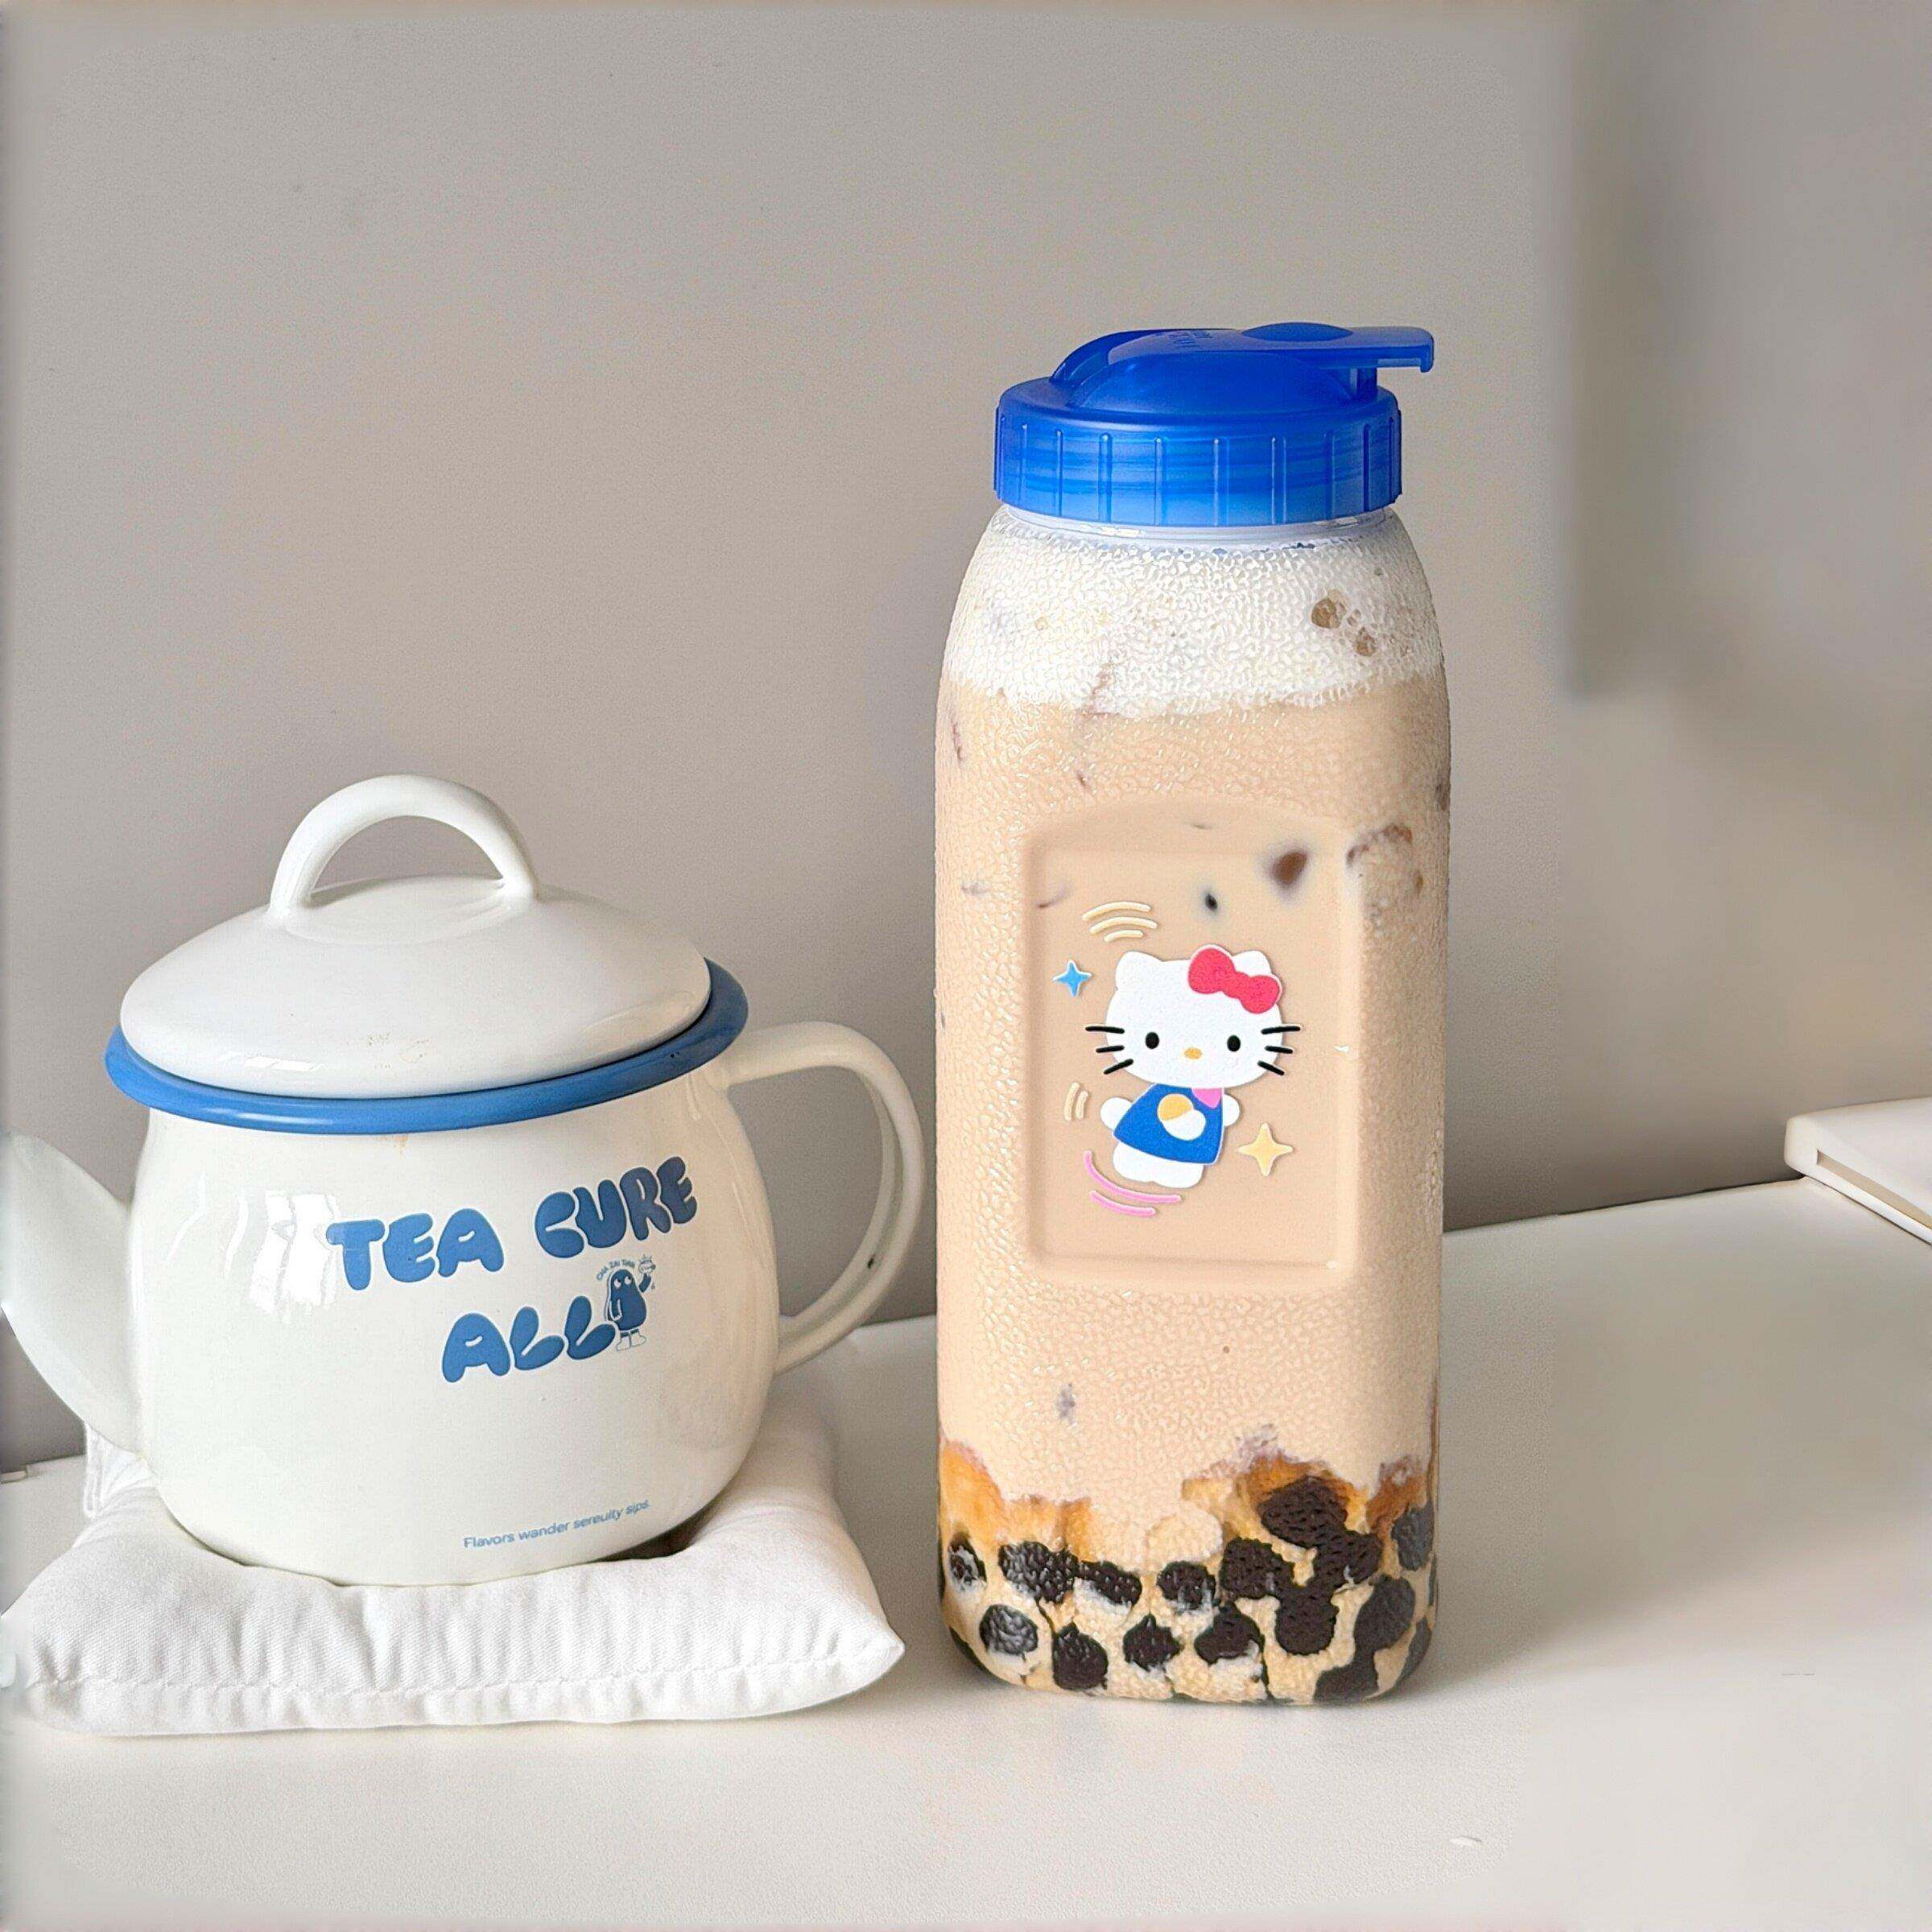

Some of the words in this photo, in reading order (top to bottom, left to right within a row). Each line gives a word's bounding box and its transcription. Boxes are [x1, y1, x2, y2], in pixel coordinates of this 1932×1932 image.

[325, 1208, 505, 1291] TEA
[534, 1157, 698, 1259] CURE
[441, 1295, 616, 1383] ALL
[463, 1534, 515, 1549] Flavors
[518, 1522, 570, 1542] wander
